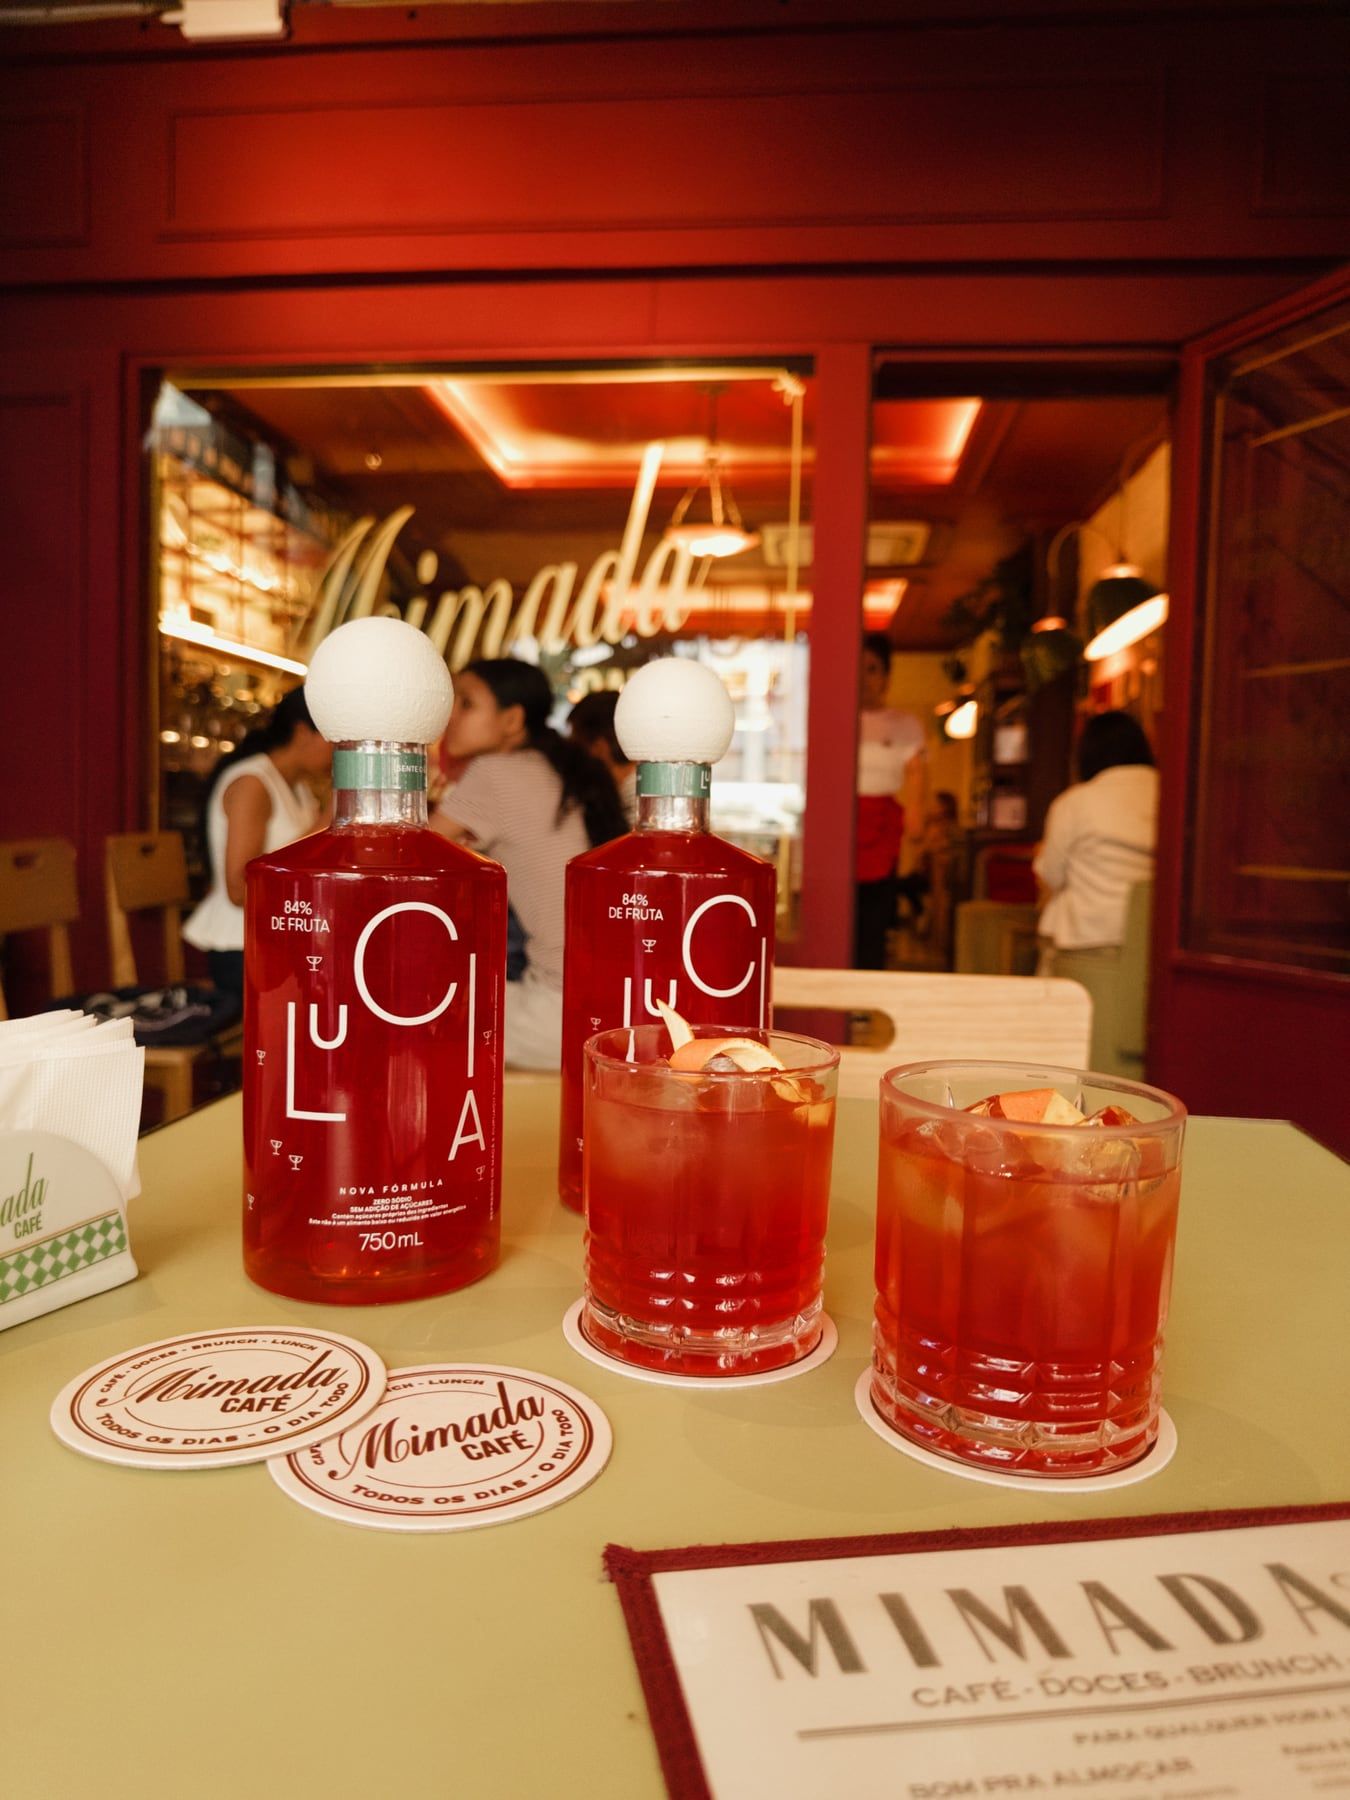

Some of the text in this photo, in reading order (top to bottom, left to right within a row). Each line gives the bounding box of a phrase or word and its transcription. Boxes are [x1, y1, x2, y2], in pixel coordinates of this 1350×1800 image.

[284, 900, 313, 915] 84%
[622, 893, 649, 906] 84%
[608, 906, 664, 920] DE FRUTA
[271, 916, 331, 933] DE FRUTA
[338, 1178, 444, 1196] NOVA FÓRMULA
[349, 1205, 364, 1213] SEM
[373, 1198, 391, 1206] ZERO
[14, 1211, 43, 1239] CAFÉ
[131, 1350, 178, 1370] DOCES
[191, 1338, 258, 1351] BRUNCH
[271, 1339, 318, 1351] LUNCH
[96, 1350, 348, 1407] Mimada
[428, 1378, 485, 1386] LUNCH
[220, 1393, 292, 1413] CAFÉ
[96, 1413, 142, 1438] TODOS
[145, 1435, 174, 1444] OS
[182, 1434, 239, 1446] DIAS
[263, 1425, 281, 1433] O
[287, 1410, 323, 1427] DIA
[320, 1382, 349, 1408] TODO
[551, 1409, 574, 1437] TODO
[328, 1381, 545, 1480] Mimada
[460, 1429, 534, 1461] CAFÉ
[551, 1440, 573, 1460] DIA
[538, 1462, 555, 1472] O
[352, 1484, 424, 1505] TODOS
[474, 1479, 528, 1500] DIAS
[433, 1495, 465, 1505] OS
[746, 1562, 1350, 1680] MIMADA
[911, 1675, 1019, 1708] CAFÉ
[1040, 1669, 1169, 1697] DOCES
[1187, 1653, 1340, 1686] BRUNCH
[908, 1781, 978, 1799] BOM
[981, 1772, 1046, 1795] PRA
[1053, 1755, 1195, 1786] ALMOÇAR
